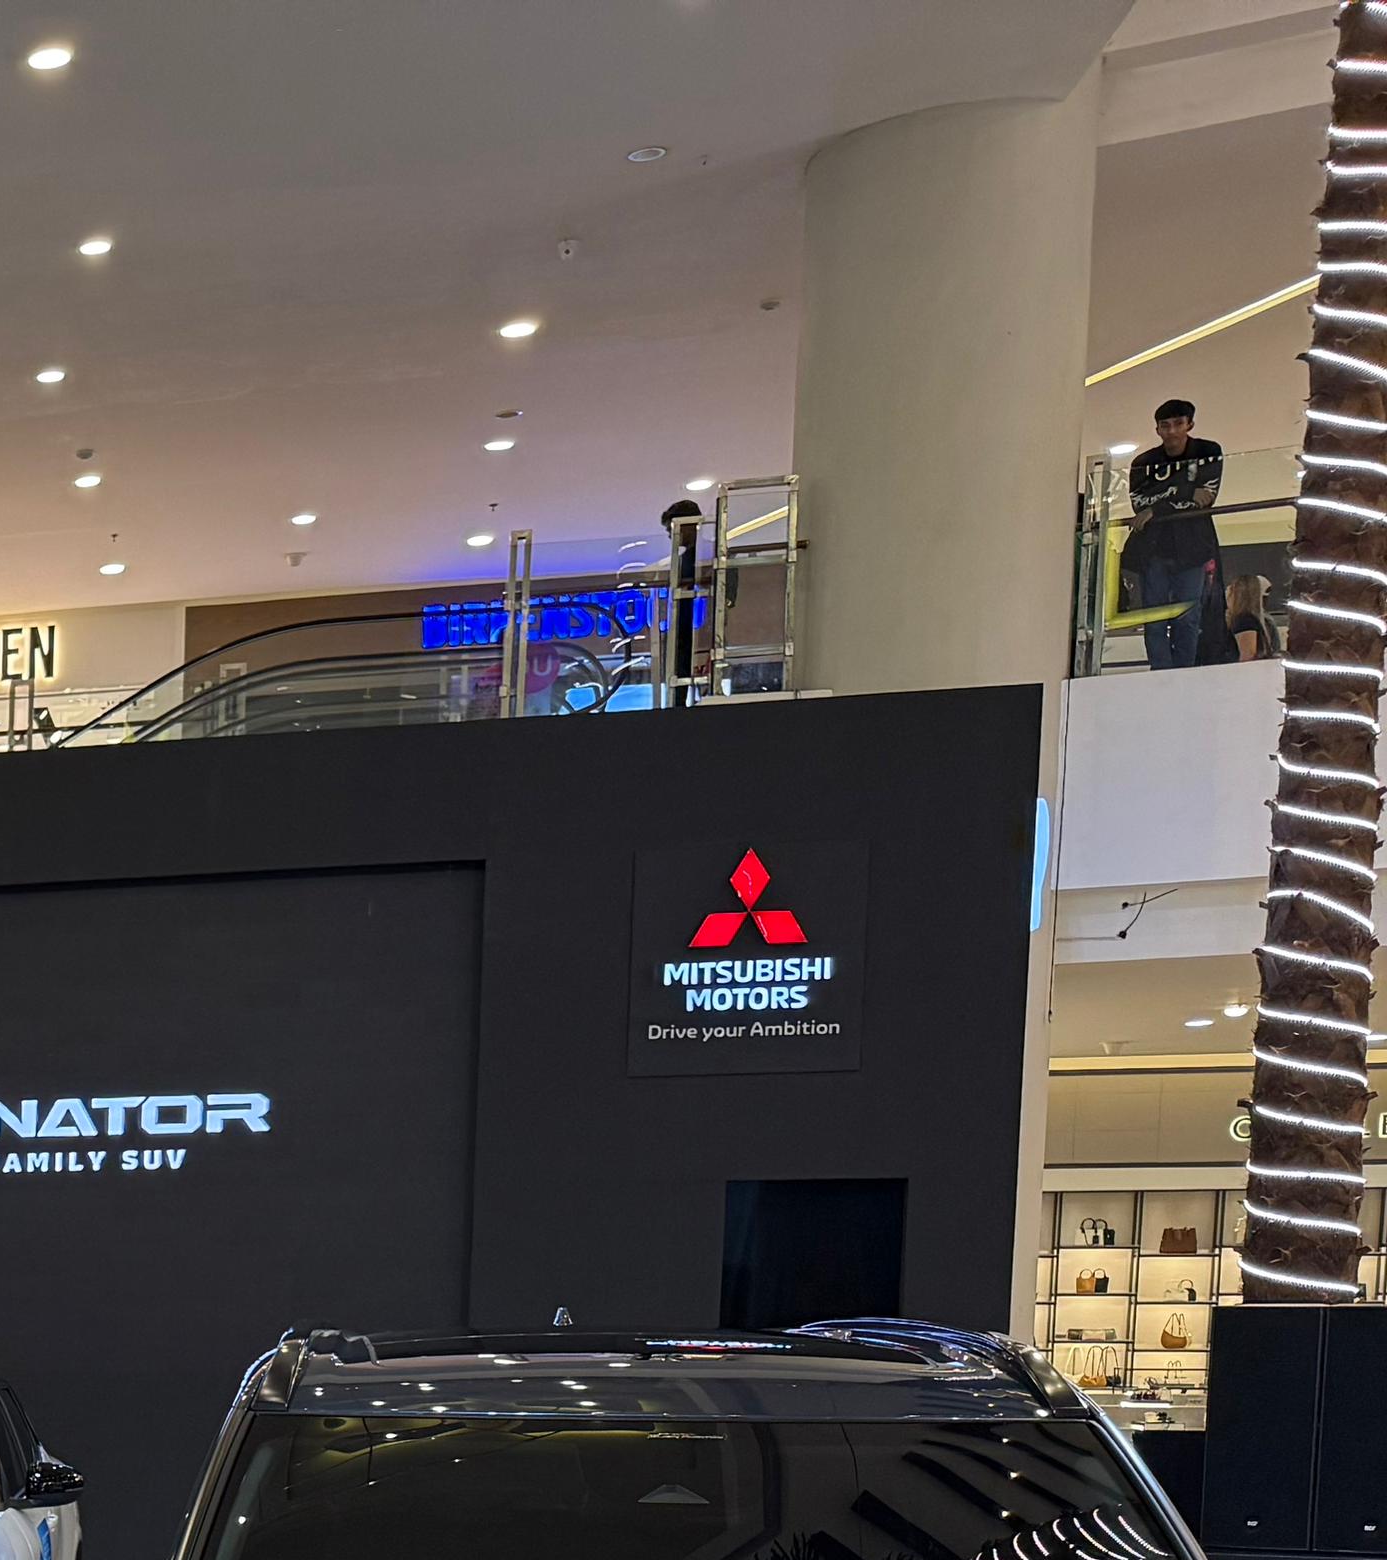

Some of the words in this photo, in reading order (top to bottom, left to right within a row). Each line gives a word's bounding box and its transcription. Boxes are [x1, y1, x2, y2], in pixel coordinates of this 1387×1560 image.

[663, 957, 833, 986] MITSUBISHI
[686, 986, 809, 1012] MOTORS
[648, 1024, 698, 1040] Drive
[702, 1026, 746, 1042] your
[749, 1020, 840, 1037] Ambition
[122, 1148, 187, 1170] SUV
